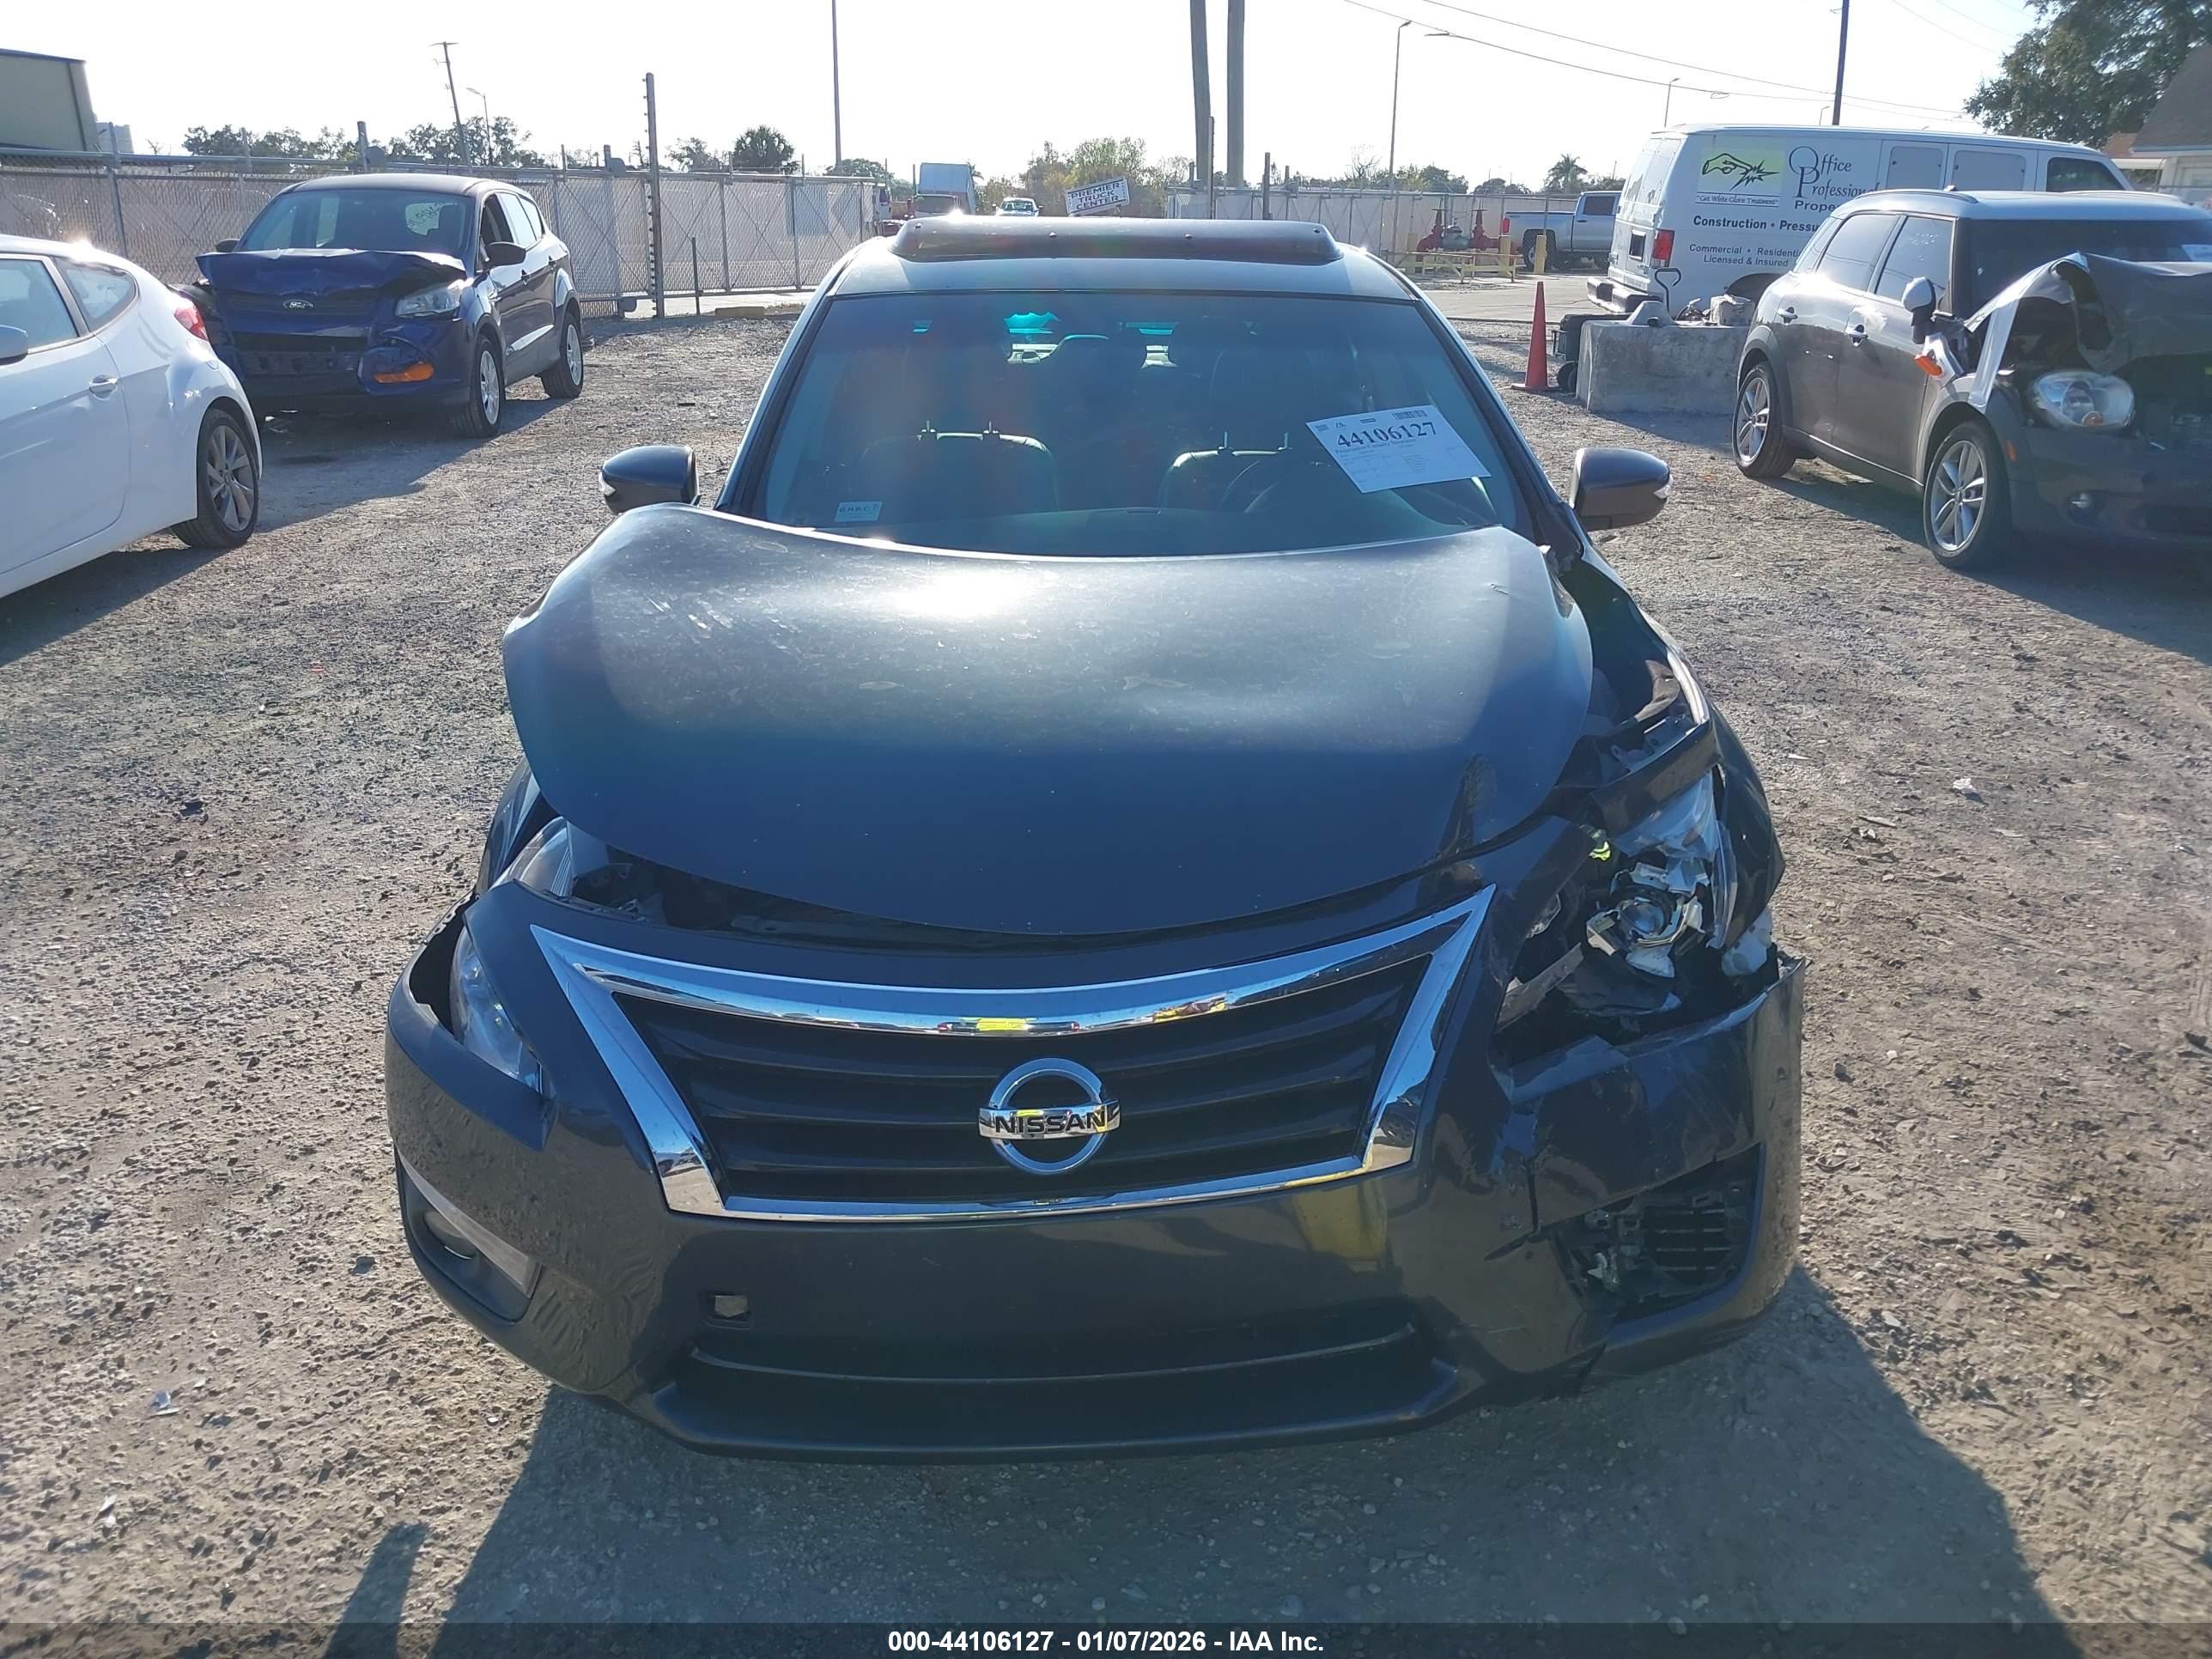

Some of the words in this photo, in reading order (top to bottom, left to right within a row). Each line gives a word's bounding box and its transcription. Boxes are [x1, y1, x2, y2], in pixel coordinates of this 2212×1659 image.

[1789, 146, 1851, 175] Office
[1071, 182, 1120, 199] PREMIER
[1079, 190, 1115, 204] TRUCK
[1076, 195, 1119, 210] CENTER
[1692, 215, 1767, 229] Construction
[1689, 243, 1742, 254] Commercial
[1704, 254, 1744, 265] Licensed
[1746, 257, 1753, 265] &
[1755, 257, 1789, 267] Insured
[1338, 422, 1437, 447] 44106127
[994, 1111, 1106, 1133] NISSAN
